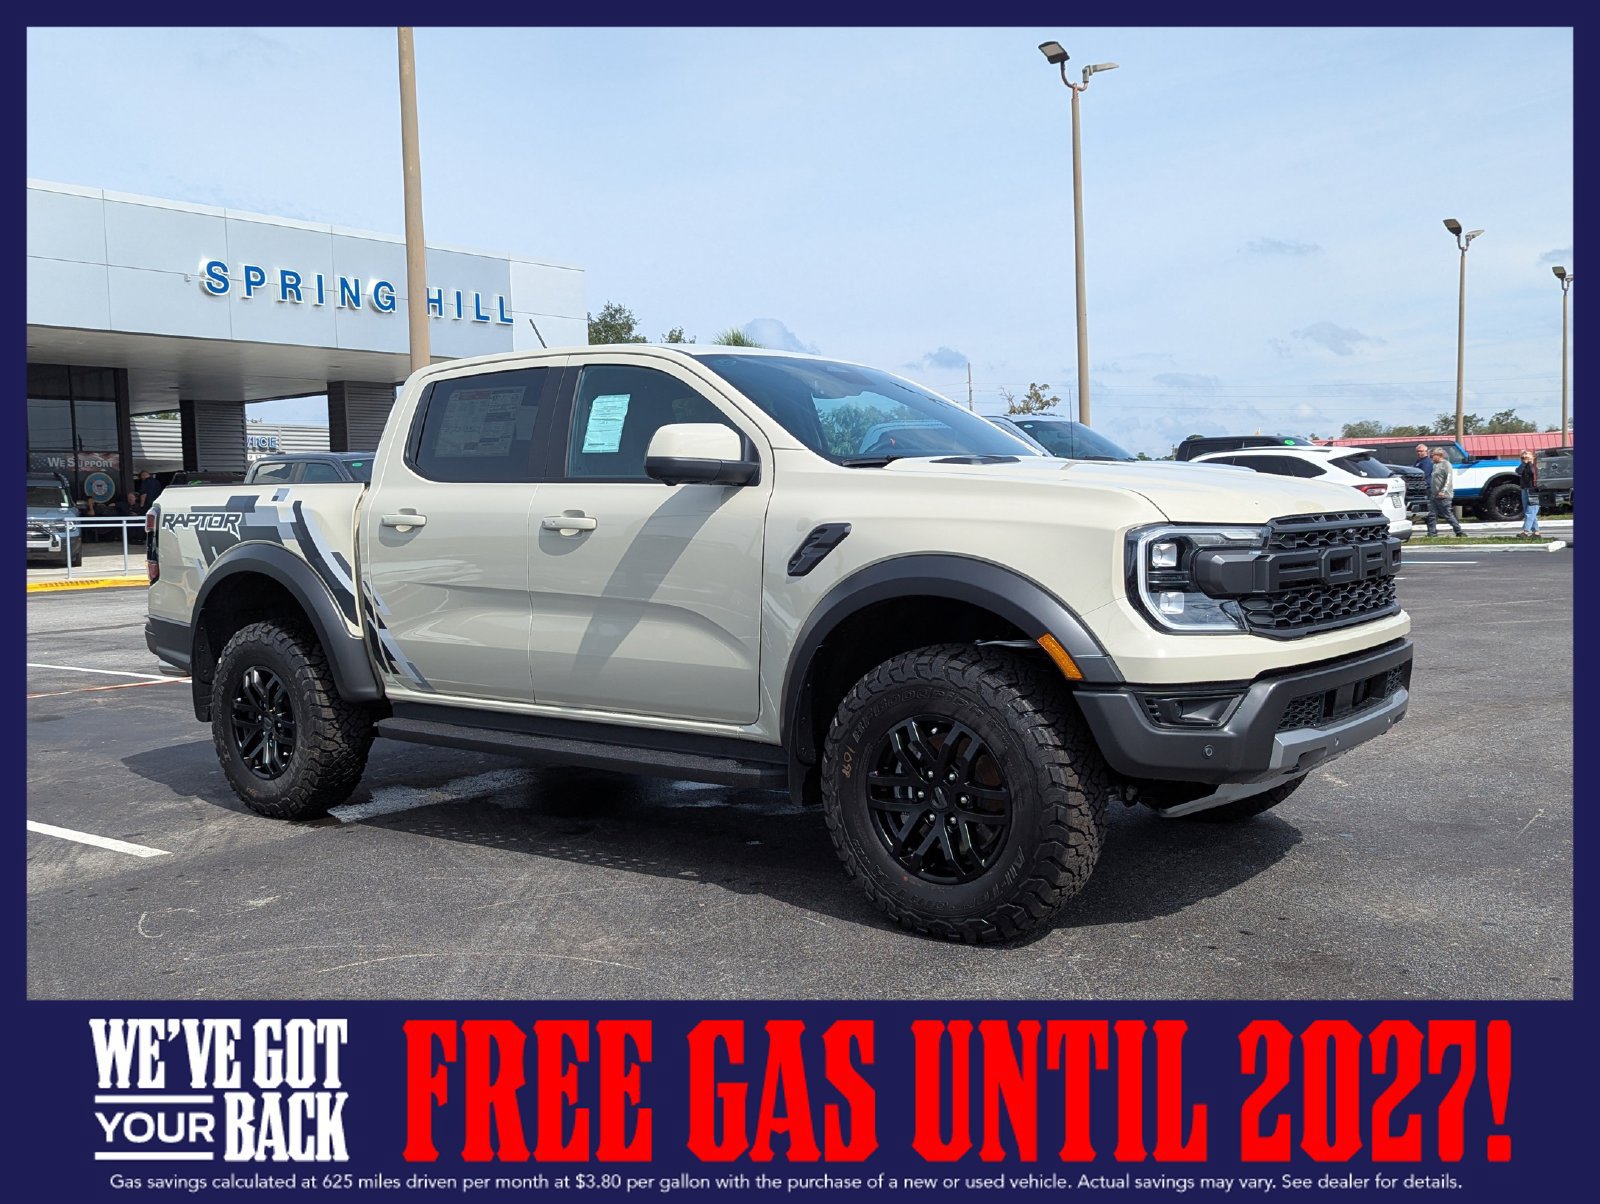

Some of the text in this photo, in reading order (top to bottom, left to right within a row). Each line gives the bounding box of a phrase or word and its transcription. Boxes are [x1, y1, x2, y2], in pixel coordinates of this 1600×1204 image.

[203, 259, 514, 325] SPRING HILL
[48, 457, 66, 467] WE
[161, 512, 242, 540] RAPTOR
